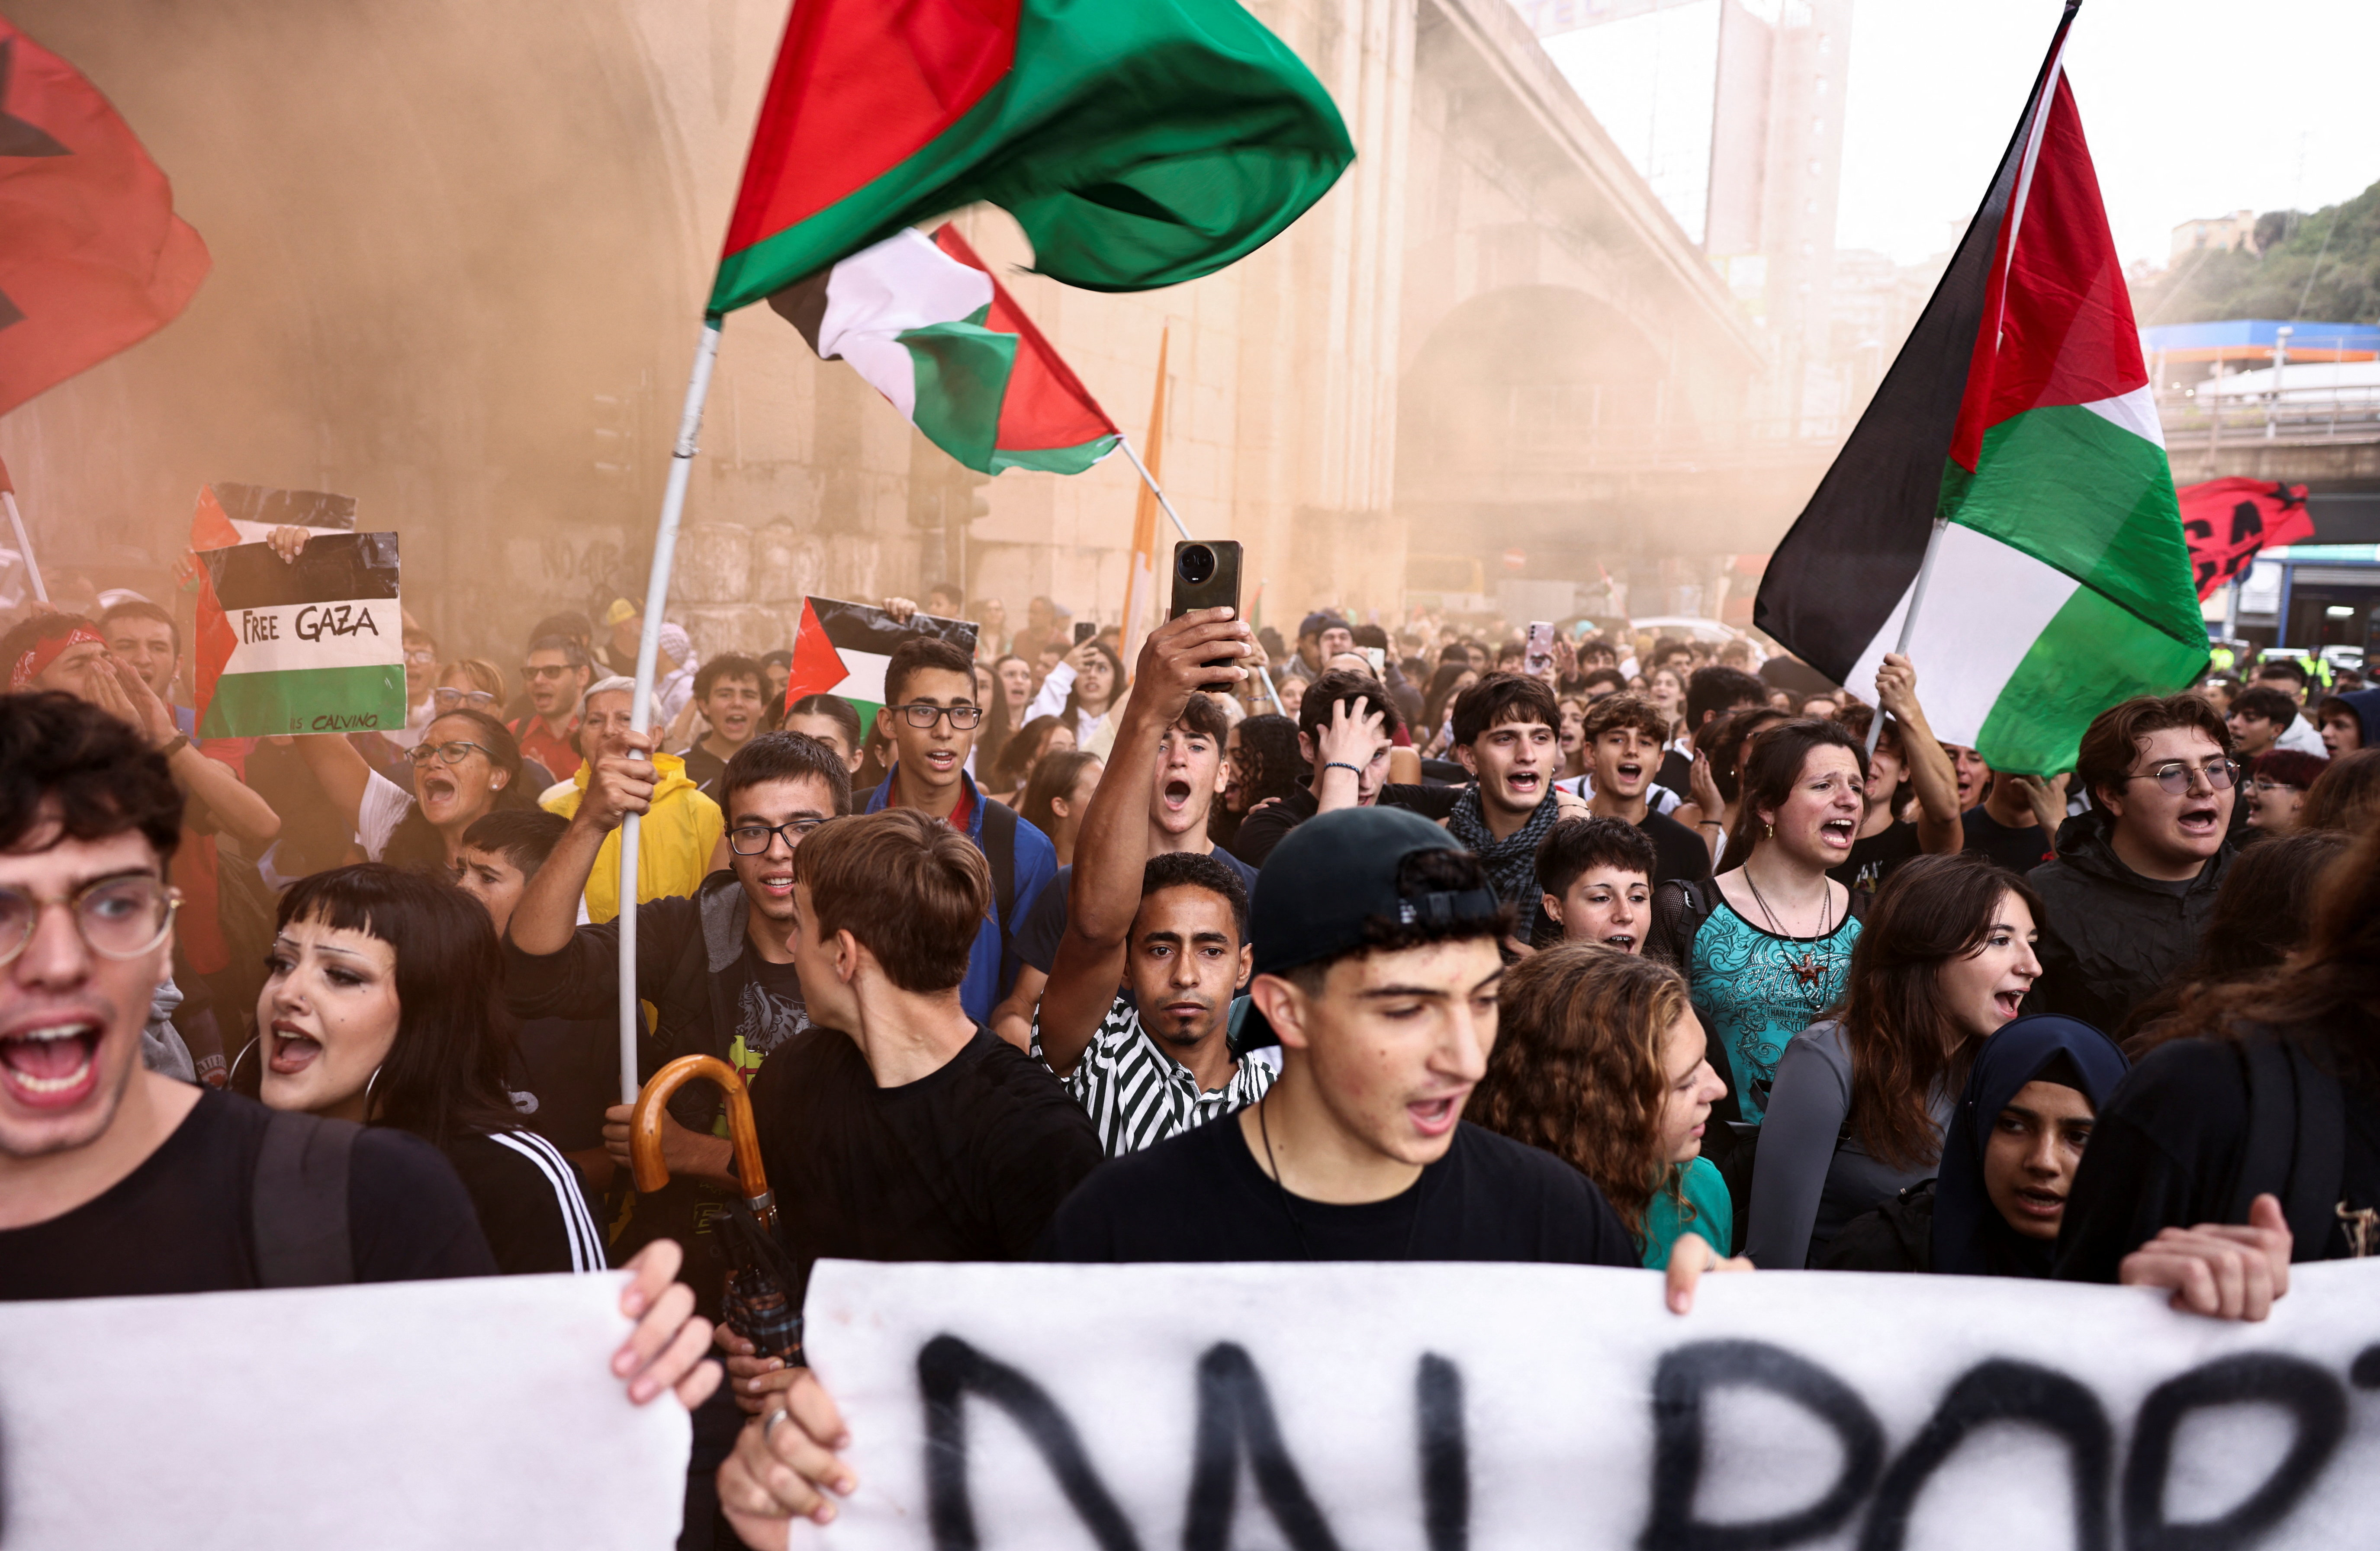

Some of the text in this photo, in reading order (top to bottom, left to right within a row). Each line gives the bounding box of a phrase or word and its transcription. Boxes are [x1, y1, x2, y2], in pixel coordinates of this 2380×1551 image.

[1524, 0, 1605, 28] TEL
[243, 605, 379, 644] FREE GAZA
[312, 712, 378, 730] CALVINO
[1785, 1000, 1811, 1009] MOTO
